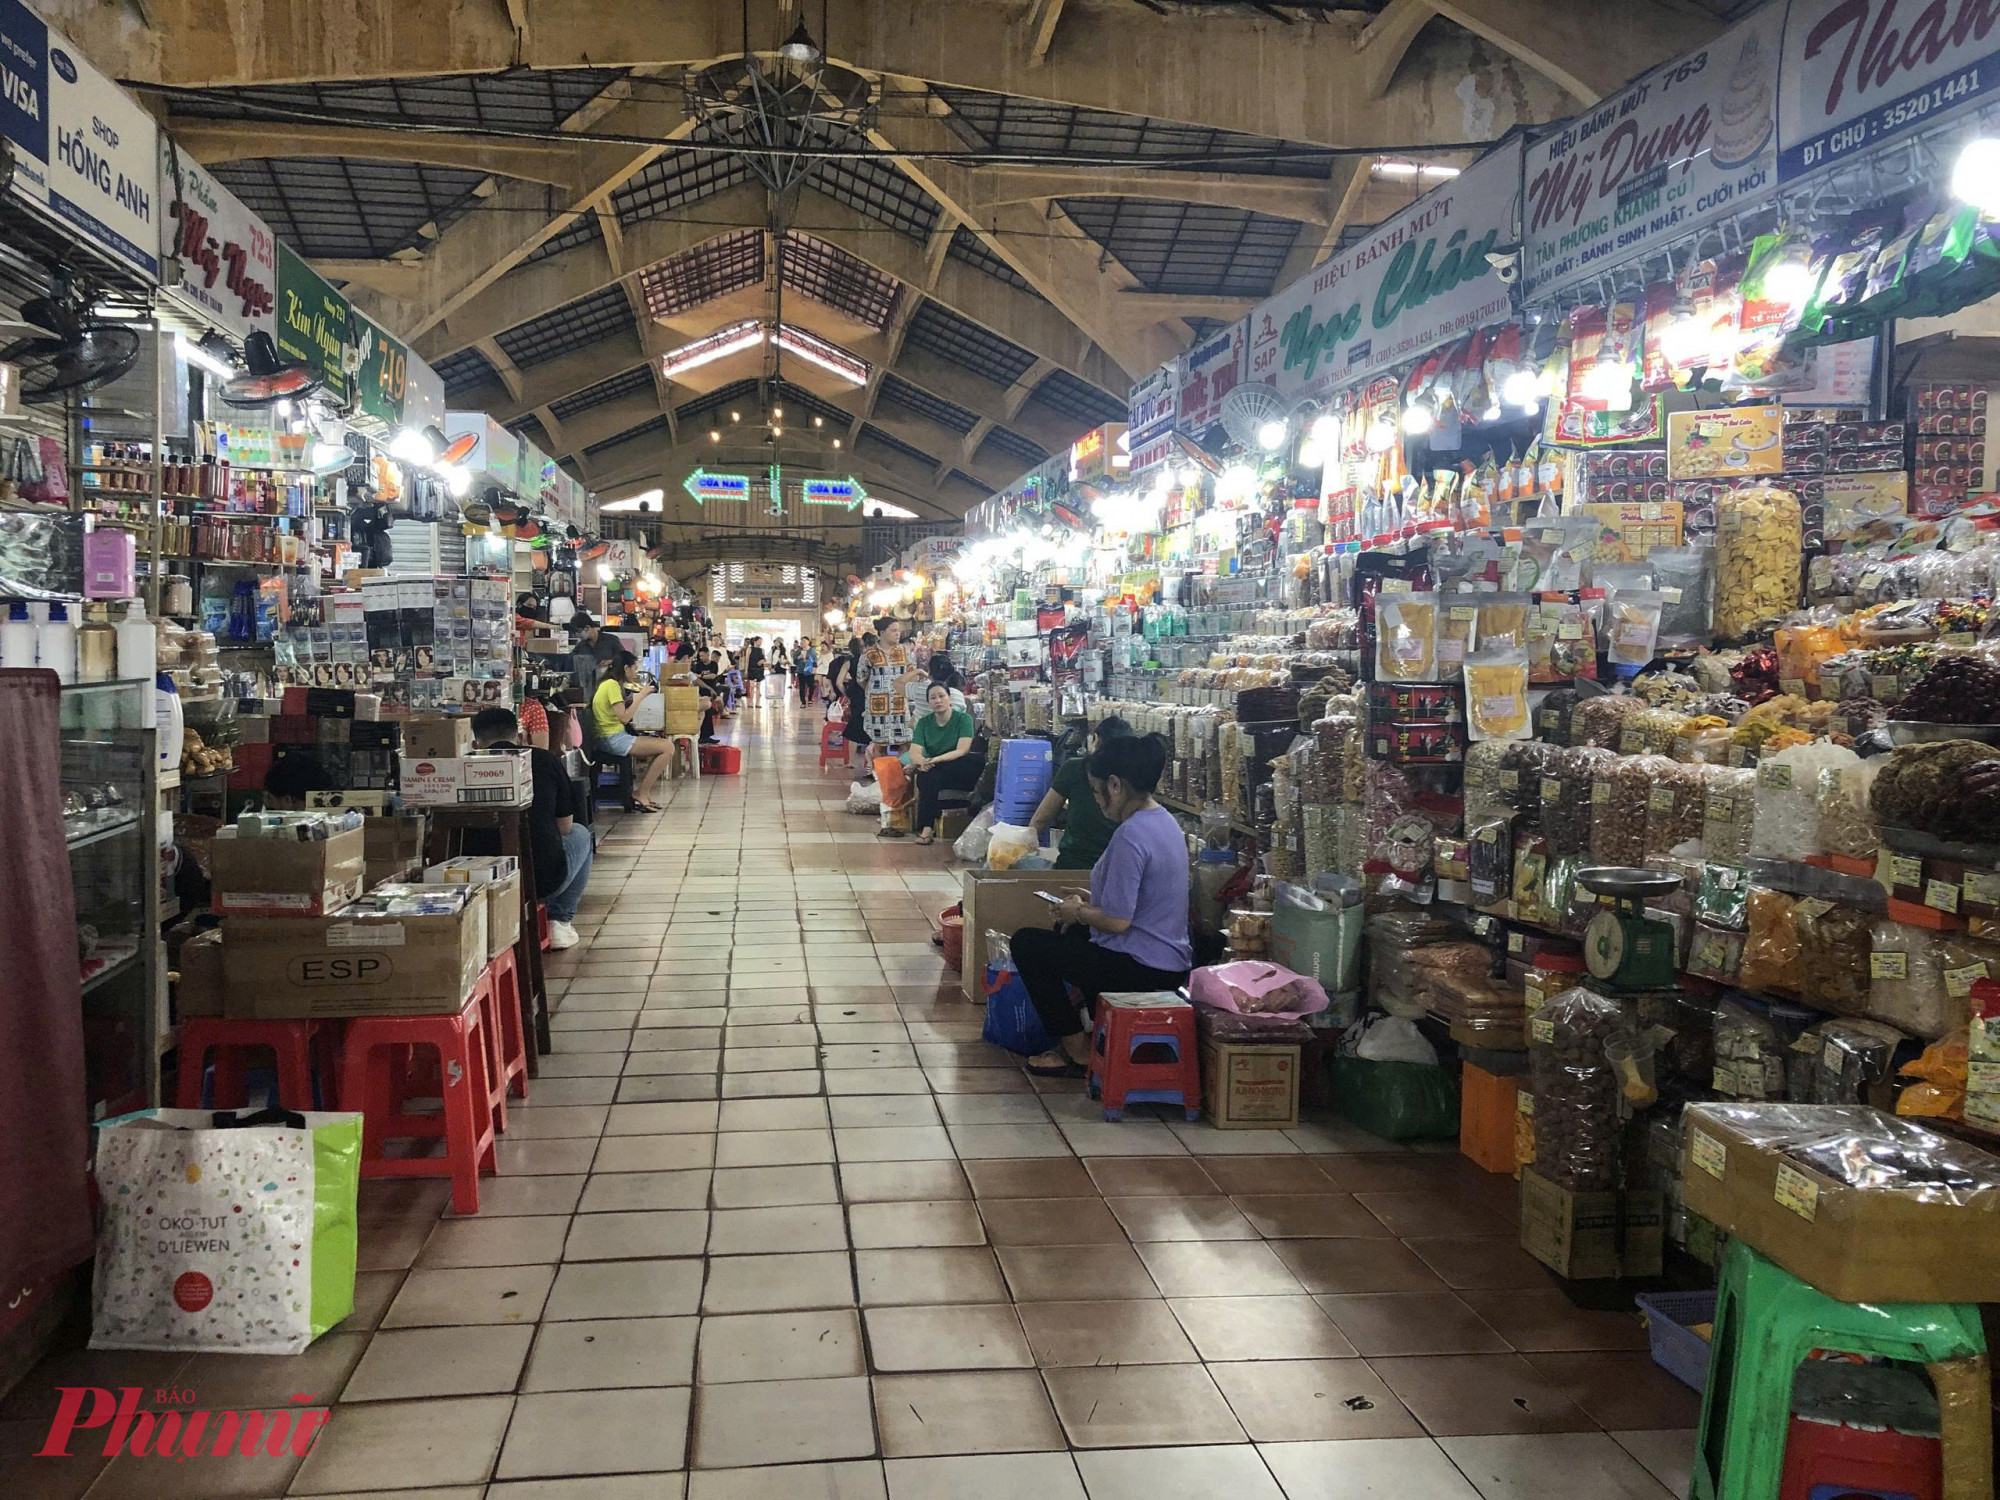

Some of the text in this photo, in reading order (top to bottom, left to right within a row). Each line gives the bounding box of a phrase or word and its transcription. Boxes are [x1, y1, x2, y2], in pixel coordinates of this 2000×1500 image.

[0, 62, 39, 121] VISA
[1549, 51, 1708, 162] HIỆU BÁNH MỨT 763
[1803, 140, 1825, 165] ĐT
[1830, 118, 1867, 149] CHỢ
[1883, 69, 1980, 130] 35201441
[92, 115, 119, 149] SHOP
[58, 126, 150, 225] HỒNG ANH
[1528, 152, 1596, 235] Mỹ
[1600, 102, 1713, 199] Dung
[250, 224, 272, 271] 723
[1313, 197, 1454, 296] HIỆU BÁNH MỨT
[1555, 256, 1574, 277] ĐẶT
[1581, 239, 1614, 265] BÁNH
[1617, 228, 1647, 249] SINH
[1650, 205, 1687, 235] NHẬT
[1696, 186, 1733, 213] CƯỚI
[1738, 167, 1767, 190] HỎI
[1560, 214, 1609, 254] PHƯƠNG
[222, 240, 274, 318] Ngọc
[1280, 304, 1361, 381] Ngọc
[1371, 228, 1498, 330] Chân
[285, 289, 312, 338] Kim
[1454, 297, 1507, 330] 0919170310
[379, 338, 407, 400] 719
[1253, 346, 1277, 373] SẠP
[722, 480, 743, 489] NAM
[473, 769, 505, 779] 790069
[302, 958, 381, 981] ESP
[158, 1240, 231, 1254] D'LIEWEN
